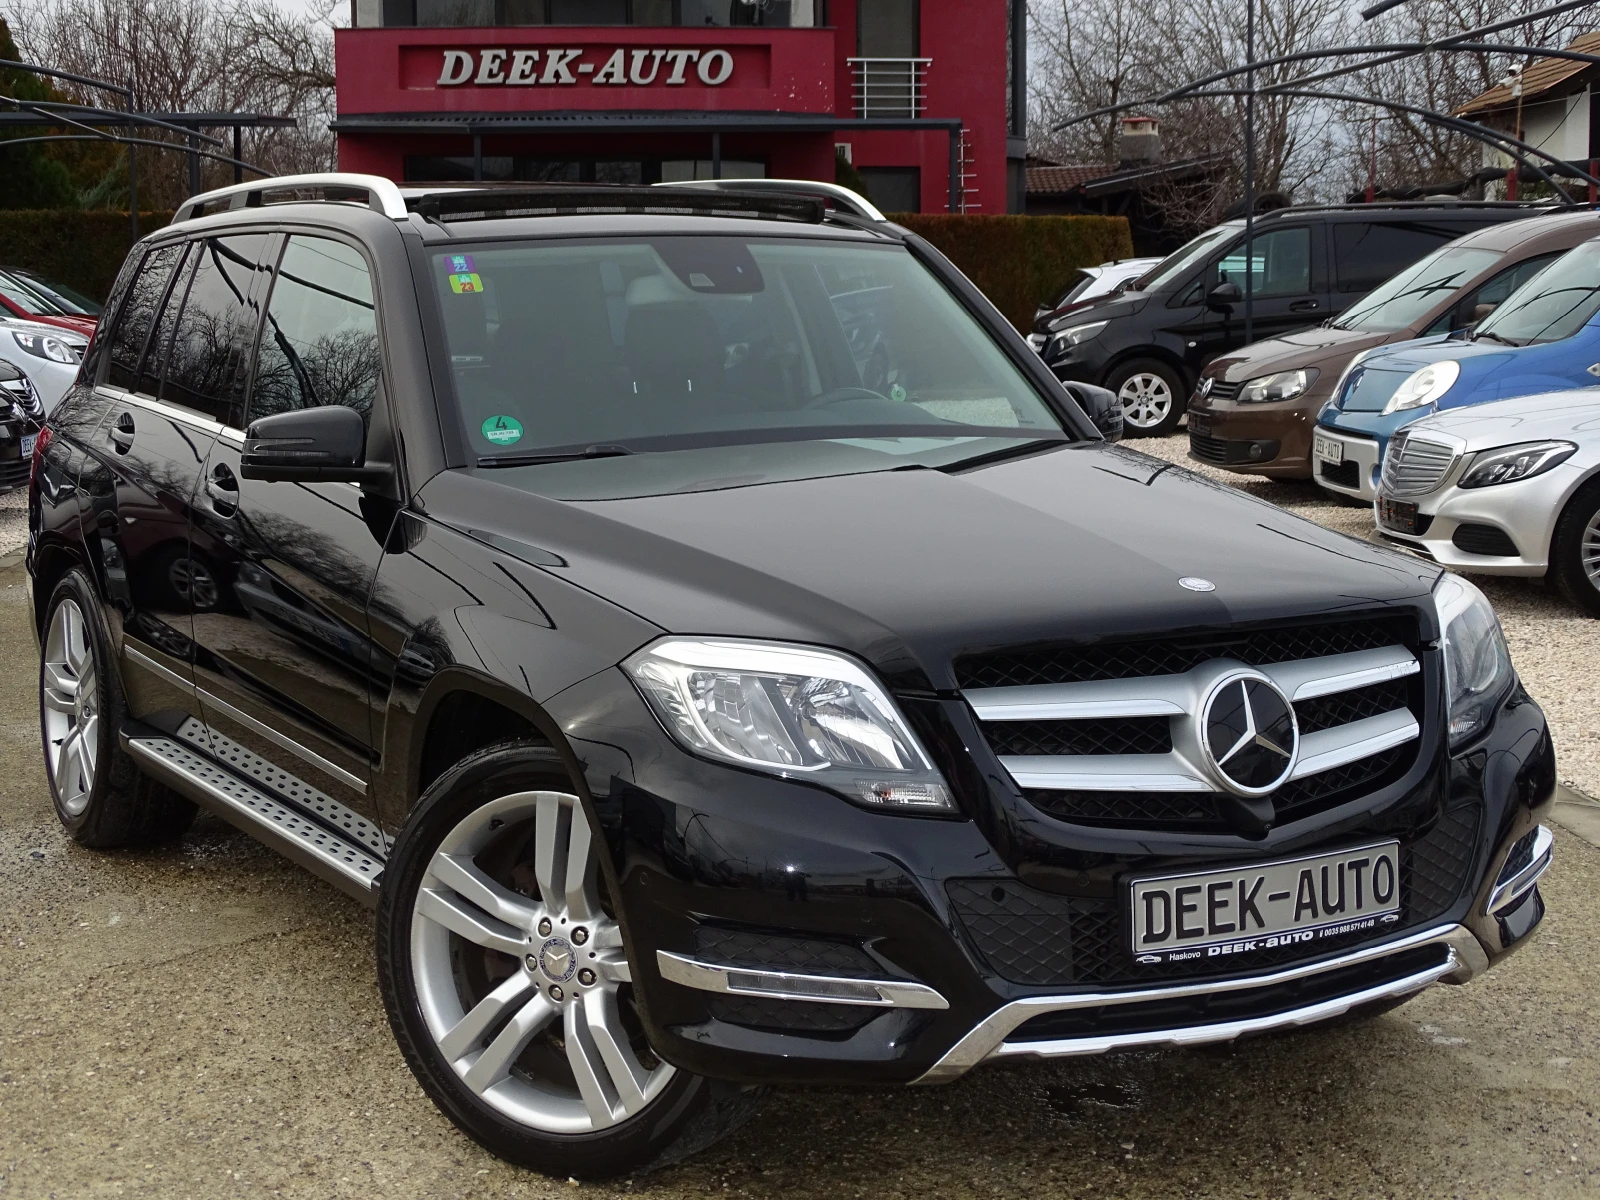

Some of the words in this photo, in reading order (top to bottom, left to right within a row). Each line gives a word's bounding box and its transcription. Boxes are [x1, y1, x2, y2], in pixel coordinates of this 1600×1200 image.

[437, 49, 734, 85] DEEK-AUTO
[453, 264, 468, 272] 22
[496, 416, 507, 430] 4
[1315, 437, 1340, 460] DEEK-AUTO
[1141, 854, 1395, 944] DEEK-AUTO
[1169, 950, 1201, 962] Haskovo
[1324, 927, 1339, 936] 0035
